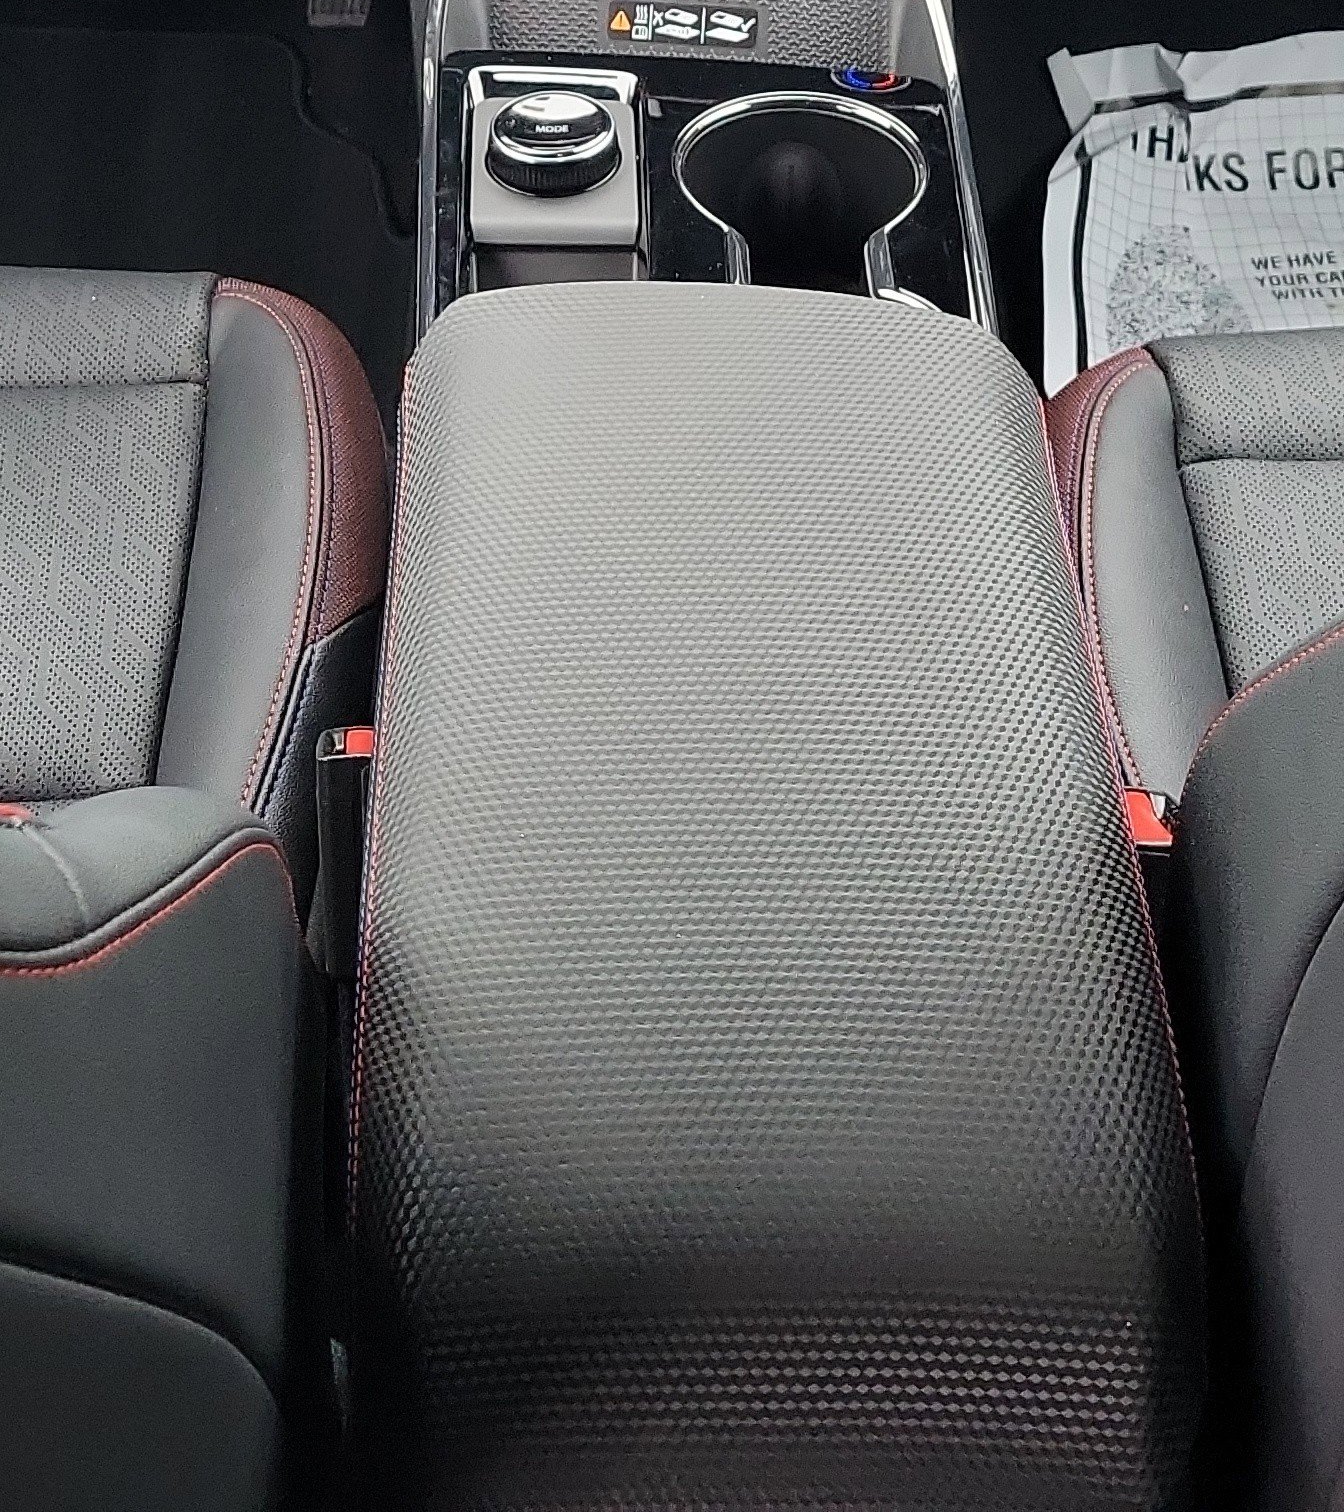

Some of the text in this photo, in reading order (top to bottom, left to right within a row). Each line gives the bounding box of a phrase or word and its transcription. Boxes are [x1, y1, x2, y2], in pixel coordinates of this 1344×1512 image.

[535, 124, 570, 134] MODE
[1252, 255, 1285, 270] WE
[1286, 250, 1337, 268] HAVE
[1256, 272, 1310, 287] YOUR
[1272, 287, 1324, 300] WITH
